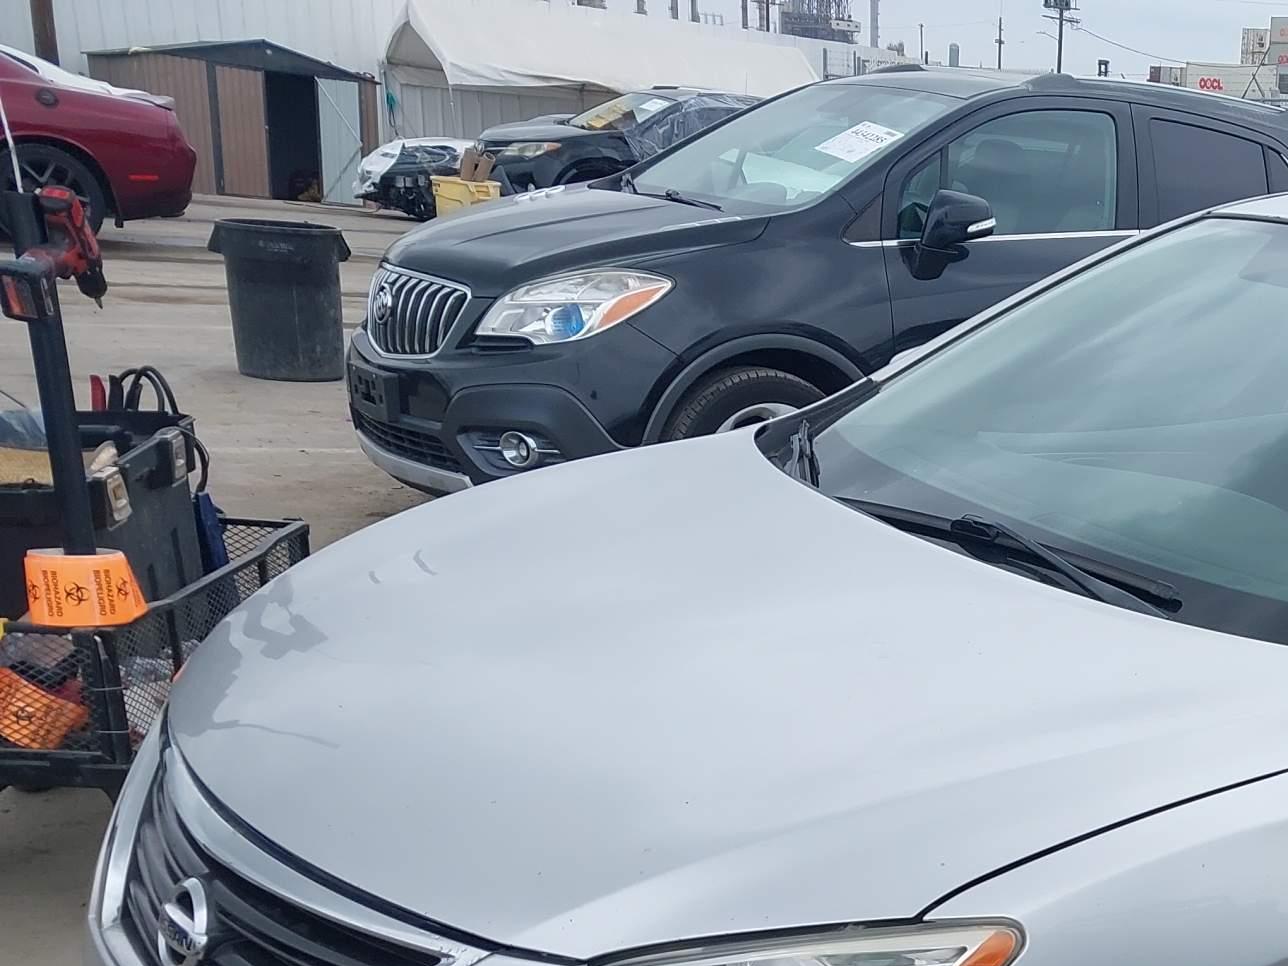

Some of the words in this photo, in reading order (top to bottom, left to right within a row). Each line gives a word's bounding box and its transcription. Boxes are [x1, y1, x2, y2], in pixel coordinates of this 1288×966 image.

[1199, 77, 1223, 90] OOCL
[41, 570, 54, 617] BIOPELIGRO
[50, 570, 63, 617] BIOHAZARD
[93, 569, 107, 616] BIOPELIGRO
[103, 569, 116, 615] BIOHAZARD
